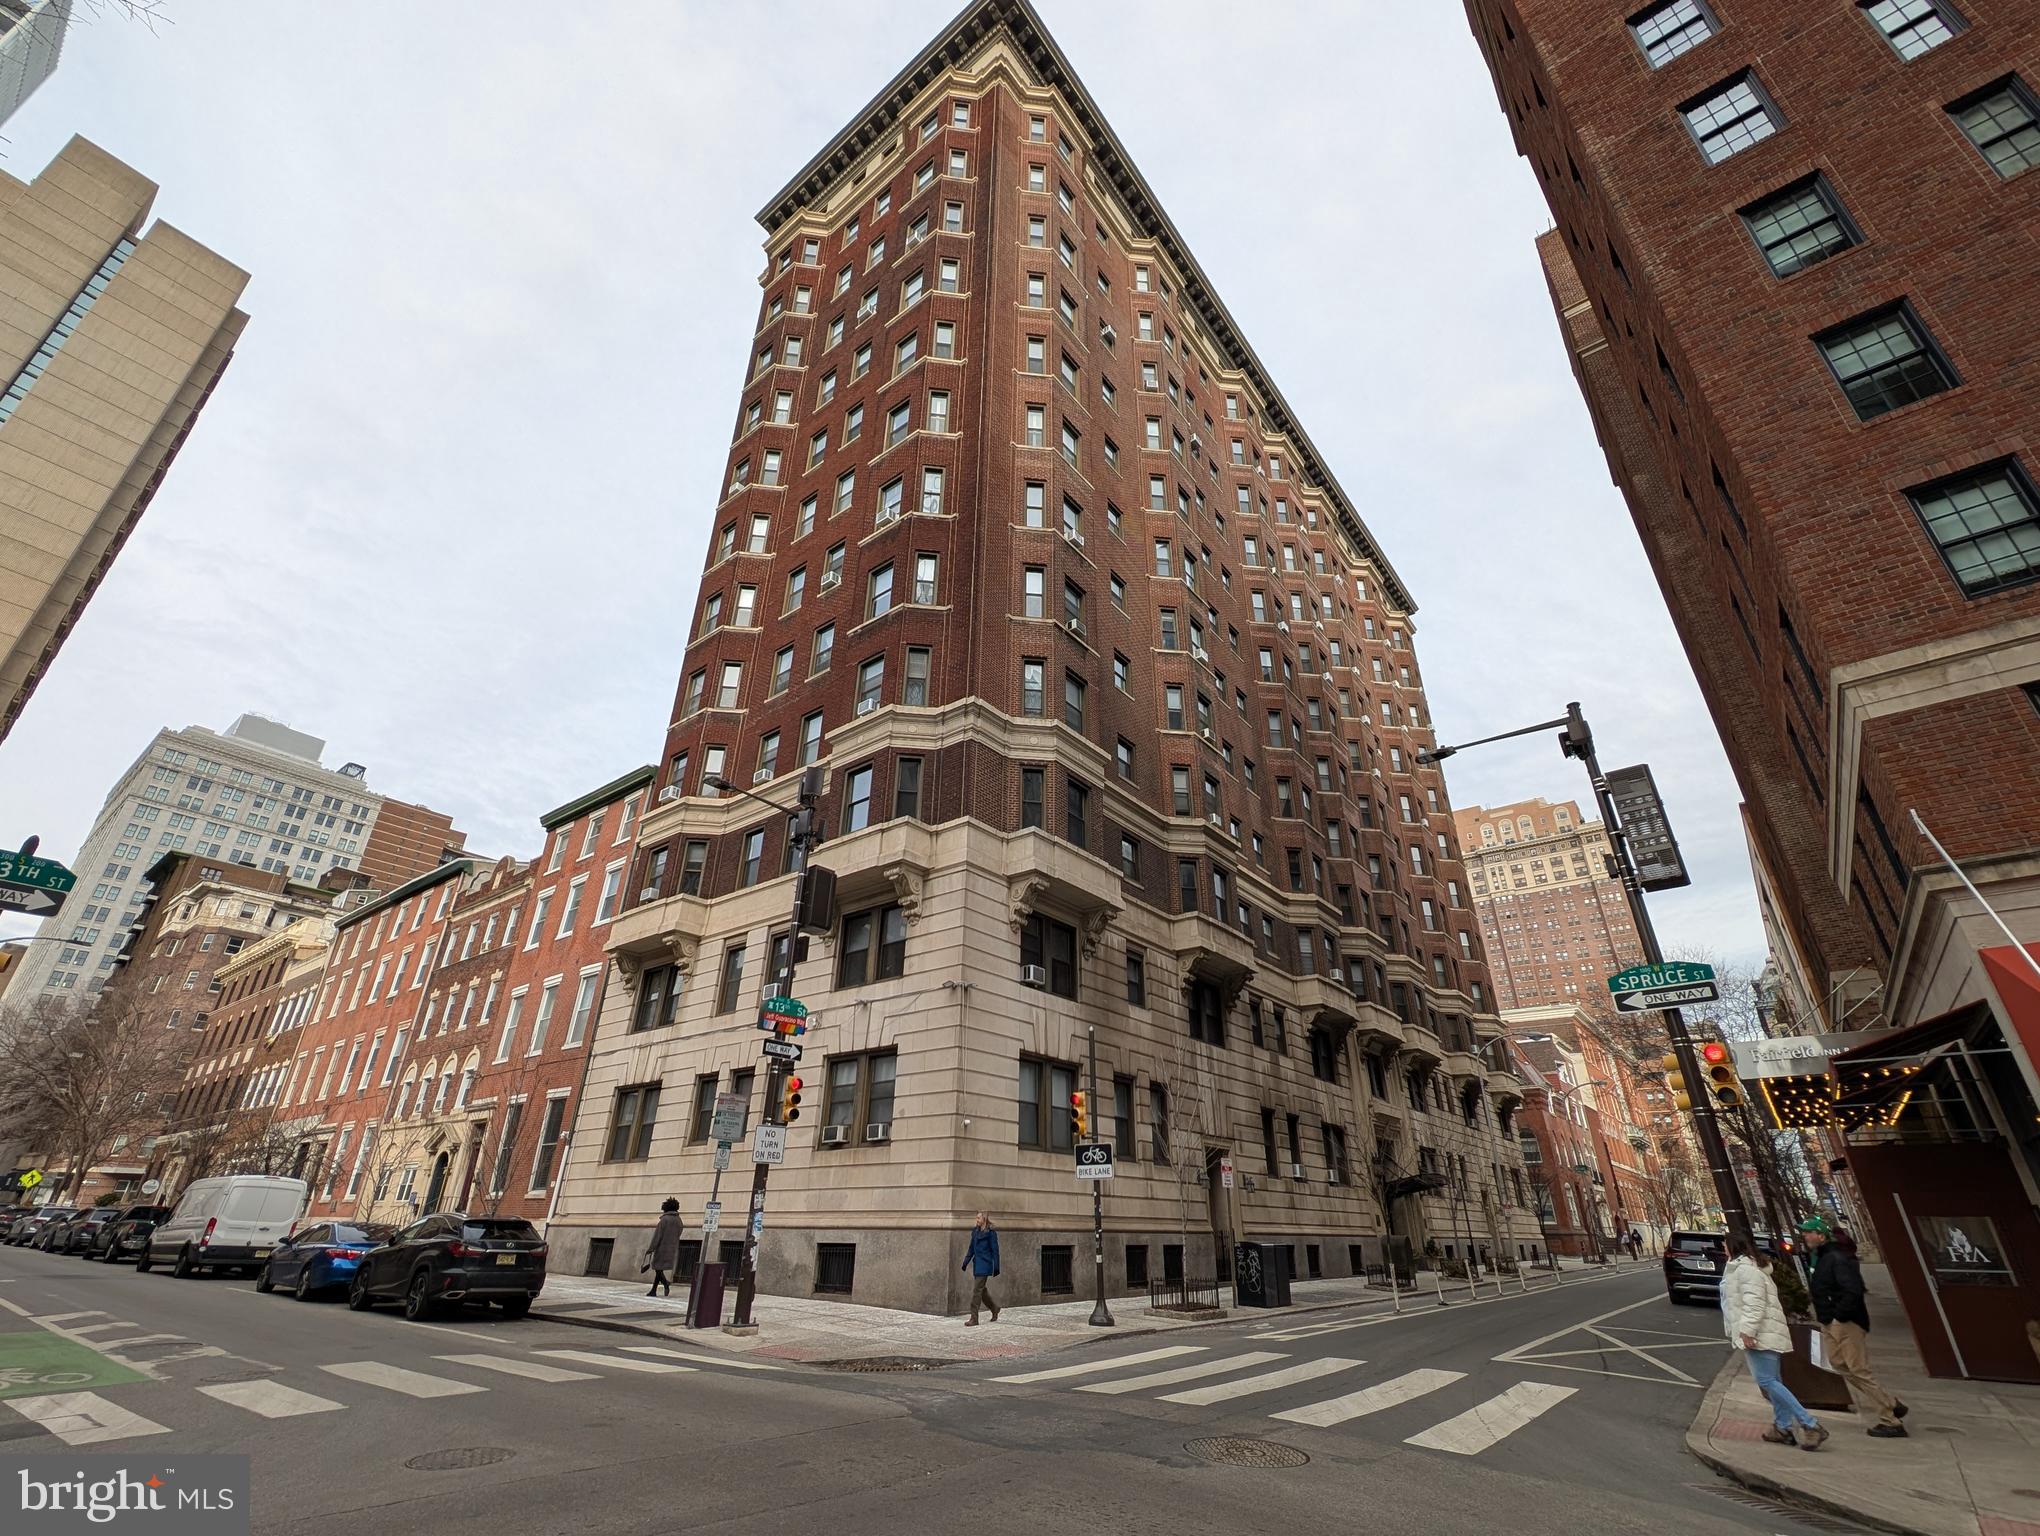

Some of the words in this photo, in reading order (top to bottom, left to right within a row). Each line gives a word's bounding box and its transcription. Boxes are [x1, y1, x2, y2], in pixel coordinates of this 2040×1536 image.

[18, 856, 26, 865] S
[47, 876, 67, 888] ST
[1618, 969, 1688, 990] SPRUCE
[1693, 970, 1705, 980] ST
[1644, 993, 1672, 1004] ONE
[1675, 988, 1705, 1000] WAY
[767, 1043, 778, 1052] ONE
[780, 1045, 791, 1054] WAY
[1750, 1045, 1819, 1062] Fairfield
[1820, 1048, 1841, 1057] INN
[765, 1129, 776, 1138] NO
[760, 1140, 778, 1149] TURN
[755, 1150, 765, 1159] ON
[766, 1151, 780, 1160] RED
[1079, 1167, 1093, 1176] BIKE
[1094, 1167, 1111, 1175] LANE
